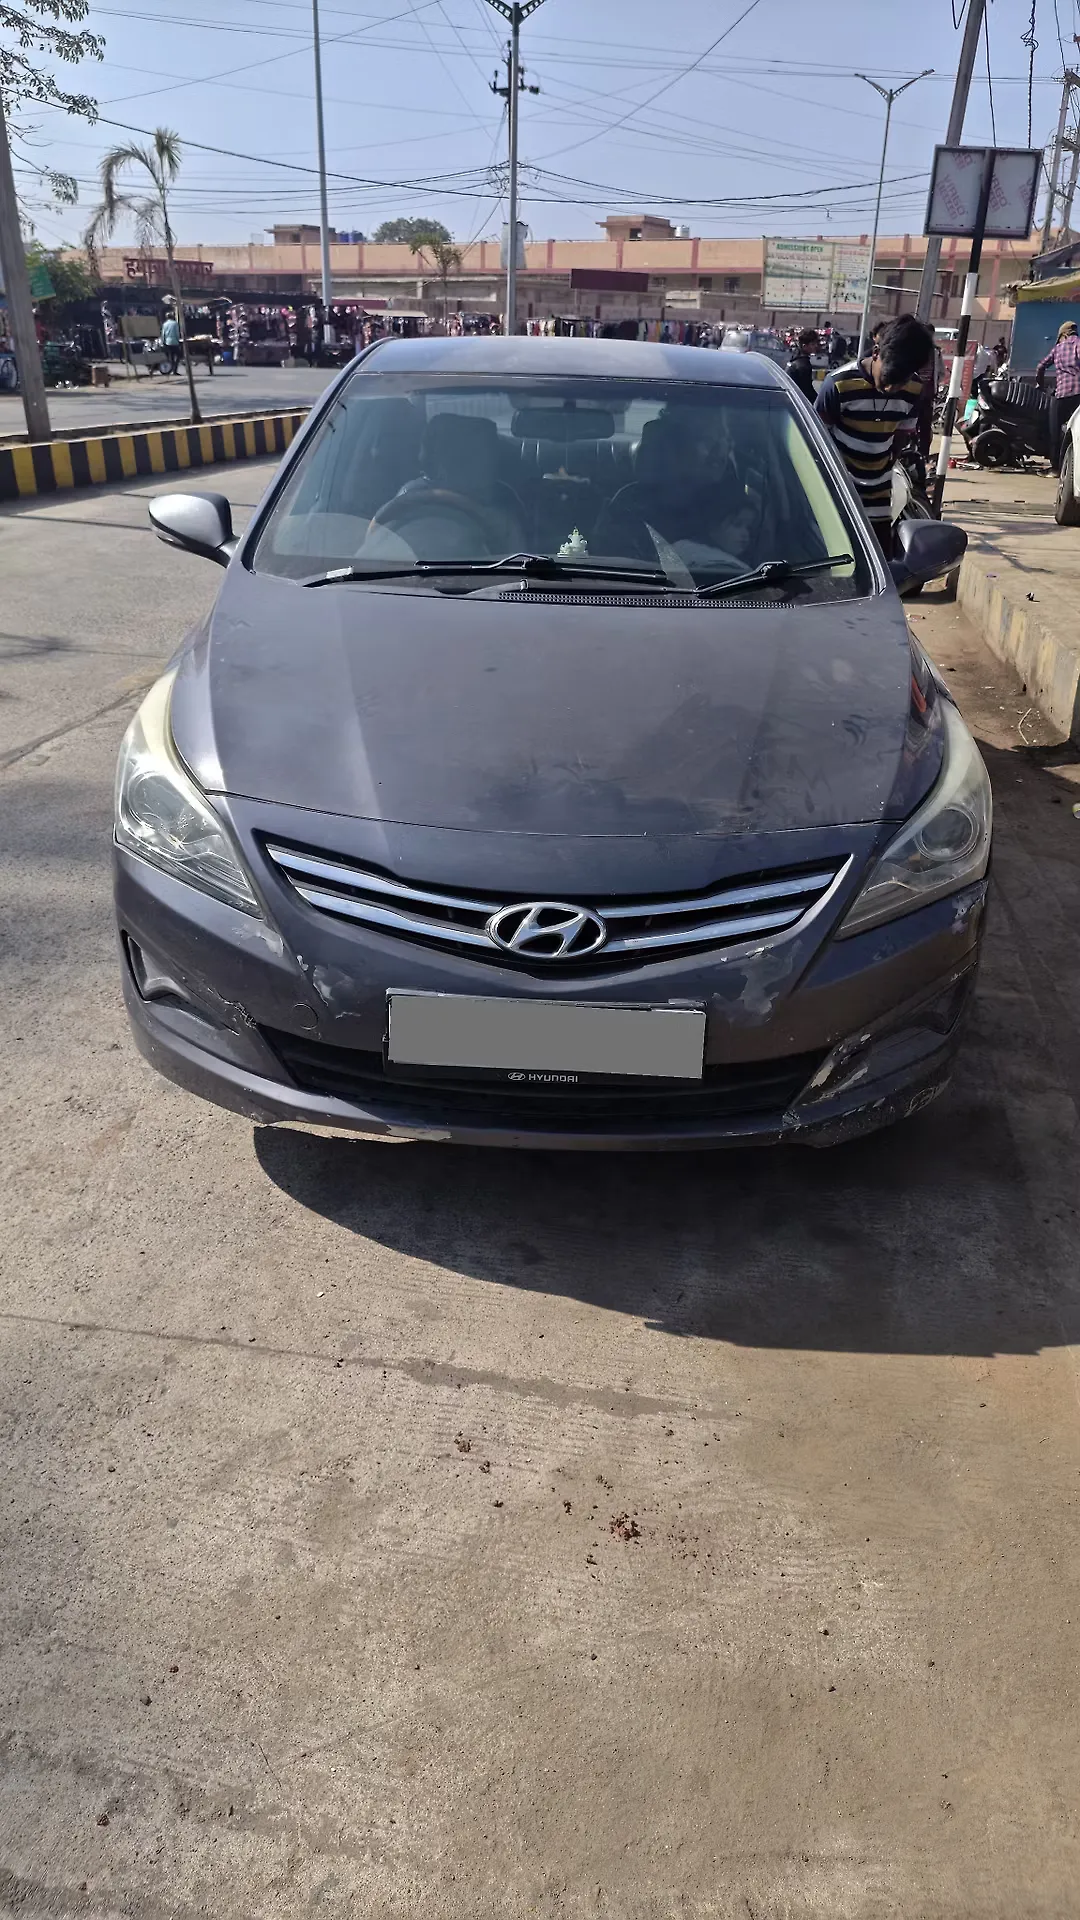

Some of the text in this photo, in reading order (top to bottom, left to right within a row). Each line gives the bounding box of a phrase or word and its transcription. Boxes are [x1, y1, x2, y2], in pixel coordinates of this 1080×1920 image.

[942, 174, 965, 216] VIRGO
[810, 245, 824, 253] OPEN
[529, 1073, 578, 1082] HYUNDAI
